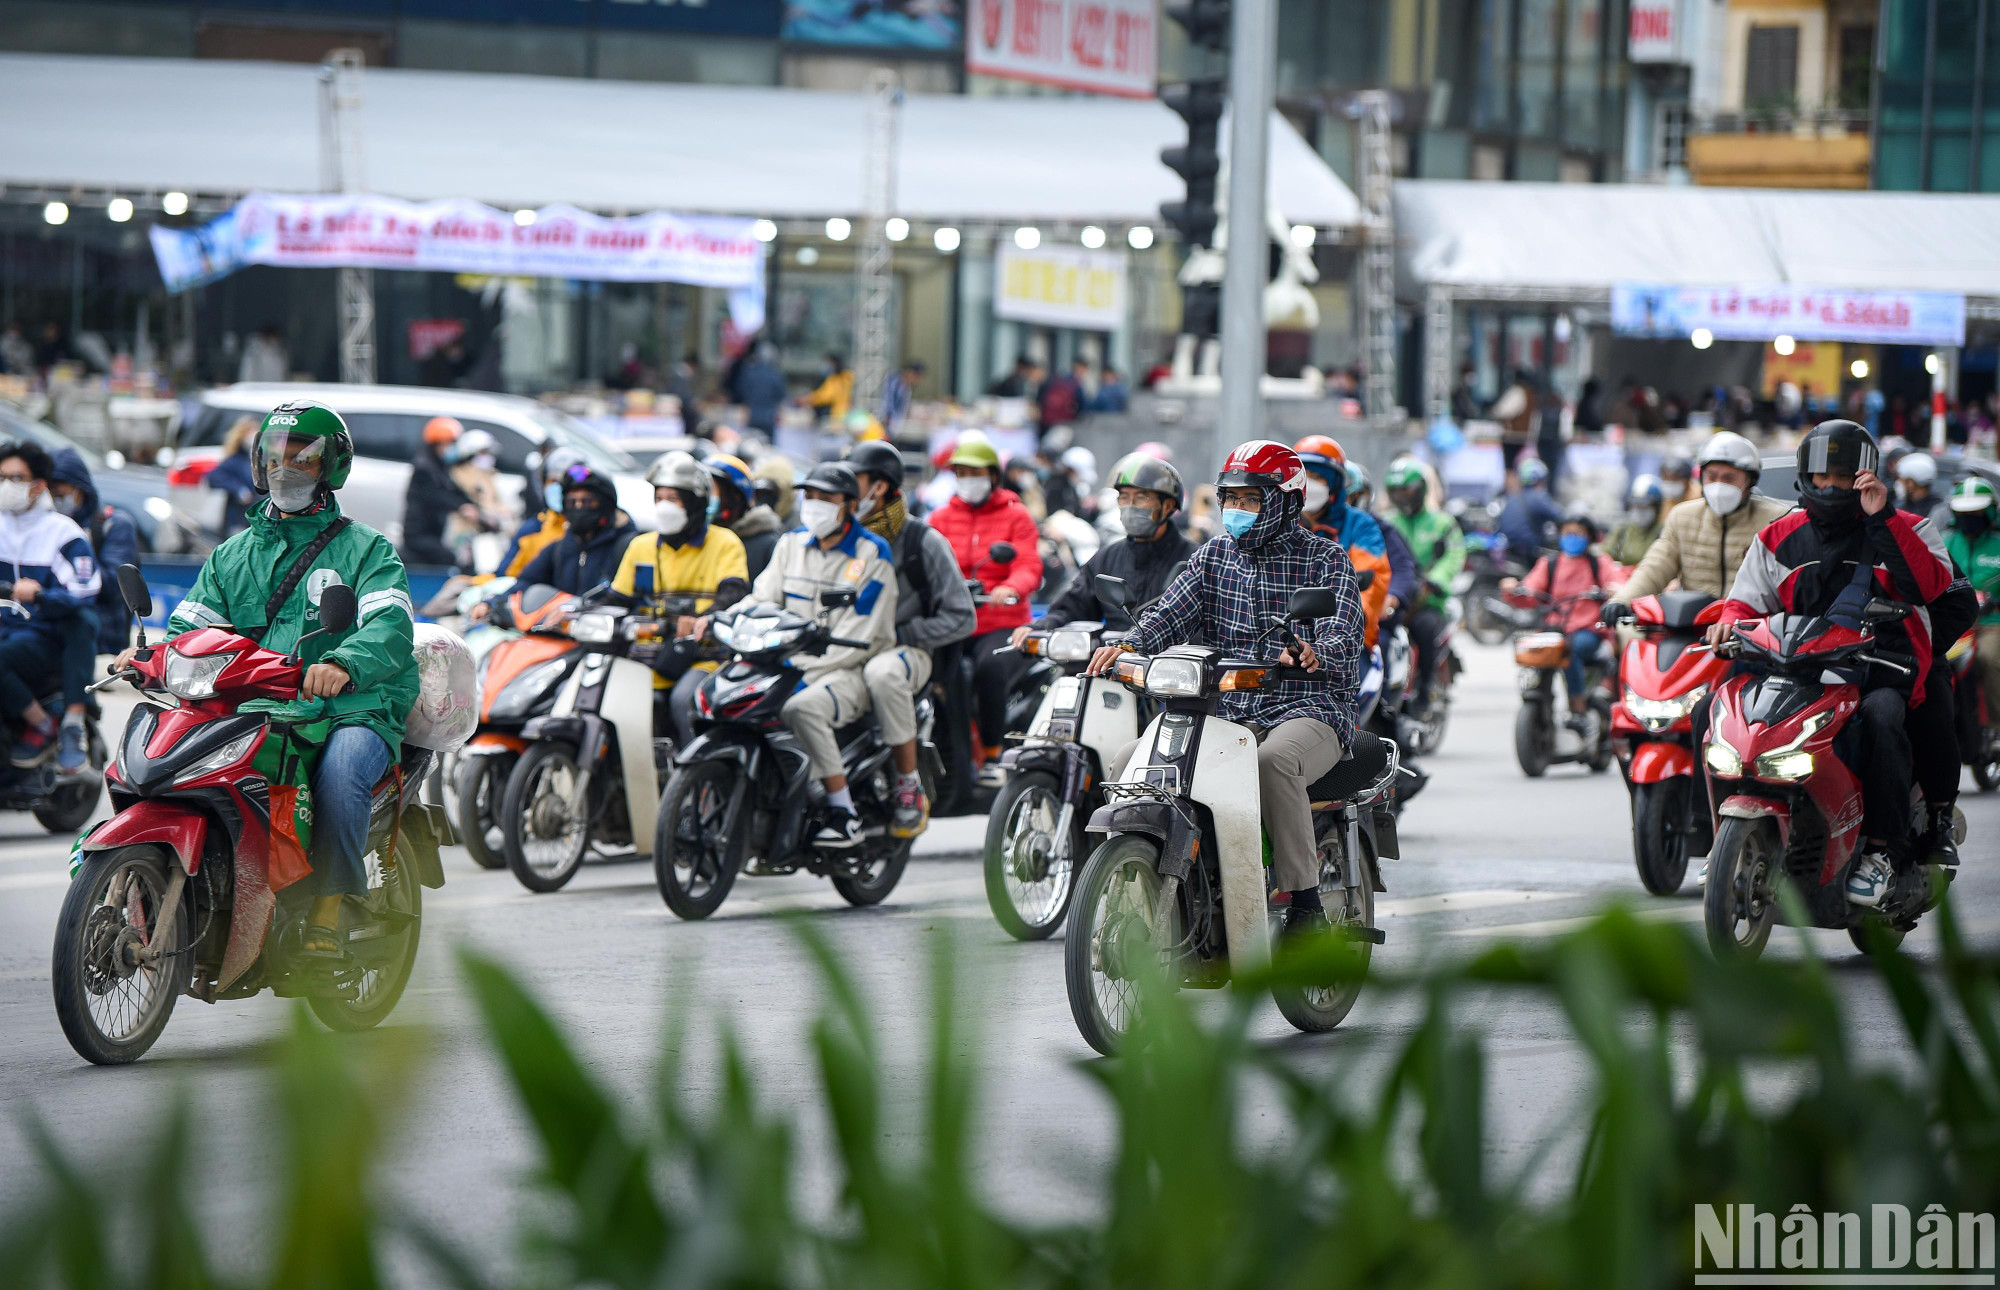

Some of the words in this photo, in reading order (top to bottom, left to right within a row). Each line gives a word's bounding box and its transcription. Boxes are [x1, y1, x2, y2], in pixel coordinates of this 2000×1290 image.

[268, 415, 299, 427] Grab
[305, 608, 321, 621] Gr
[242, 781, 266, 792] HONDA
